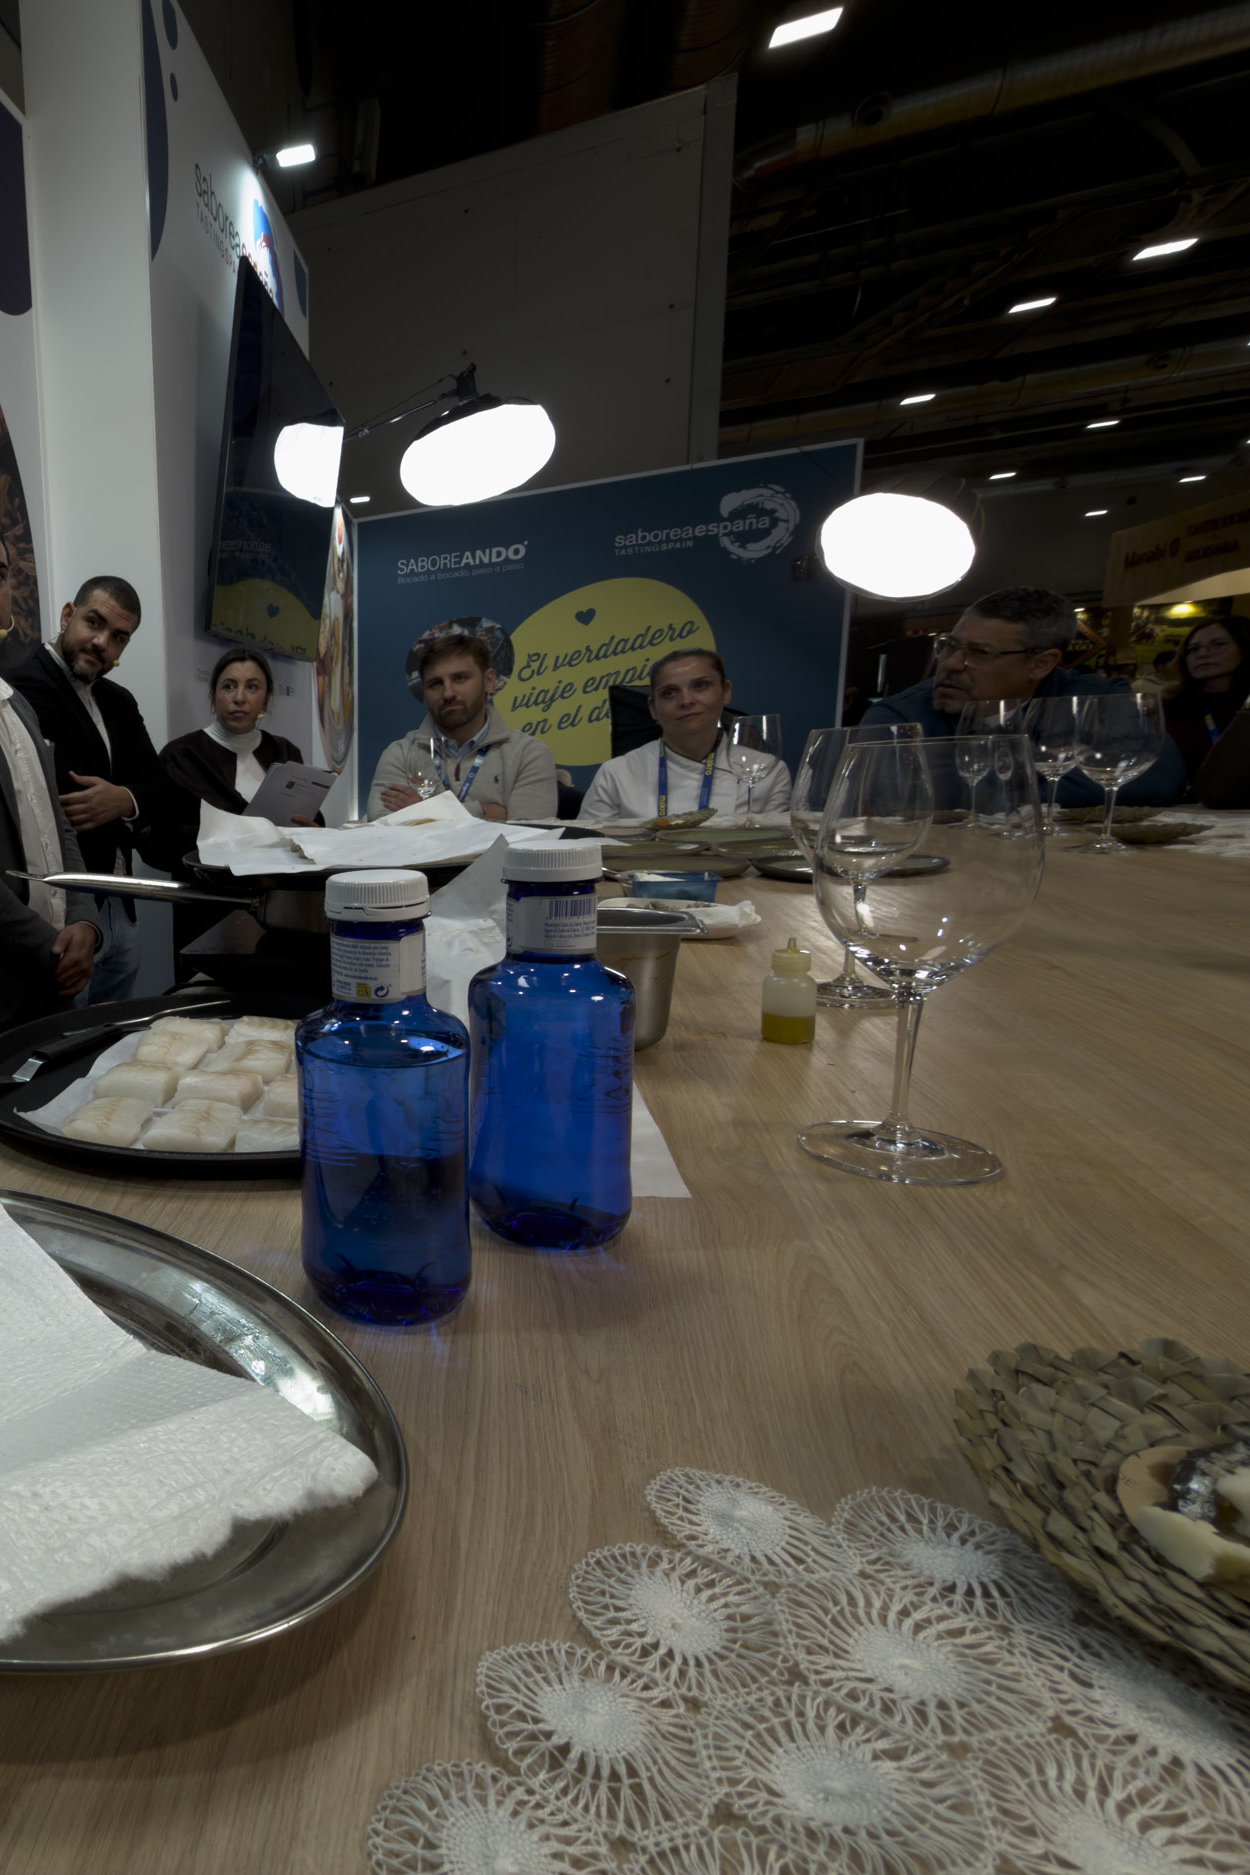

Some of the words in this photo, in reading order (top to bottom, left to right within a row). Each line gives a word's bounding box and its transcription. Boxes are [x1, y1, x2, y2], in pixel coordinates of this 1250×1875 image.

[614, 513, 771, 548] saboreaespaña
[397, 543, 527, 575] SABOREANDO
[517, 652, 548, 682] El
[552, 620, 700, 672] verdadero
[510, 679, 578, 713] viaje
[557, 704, 582, 731] el
